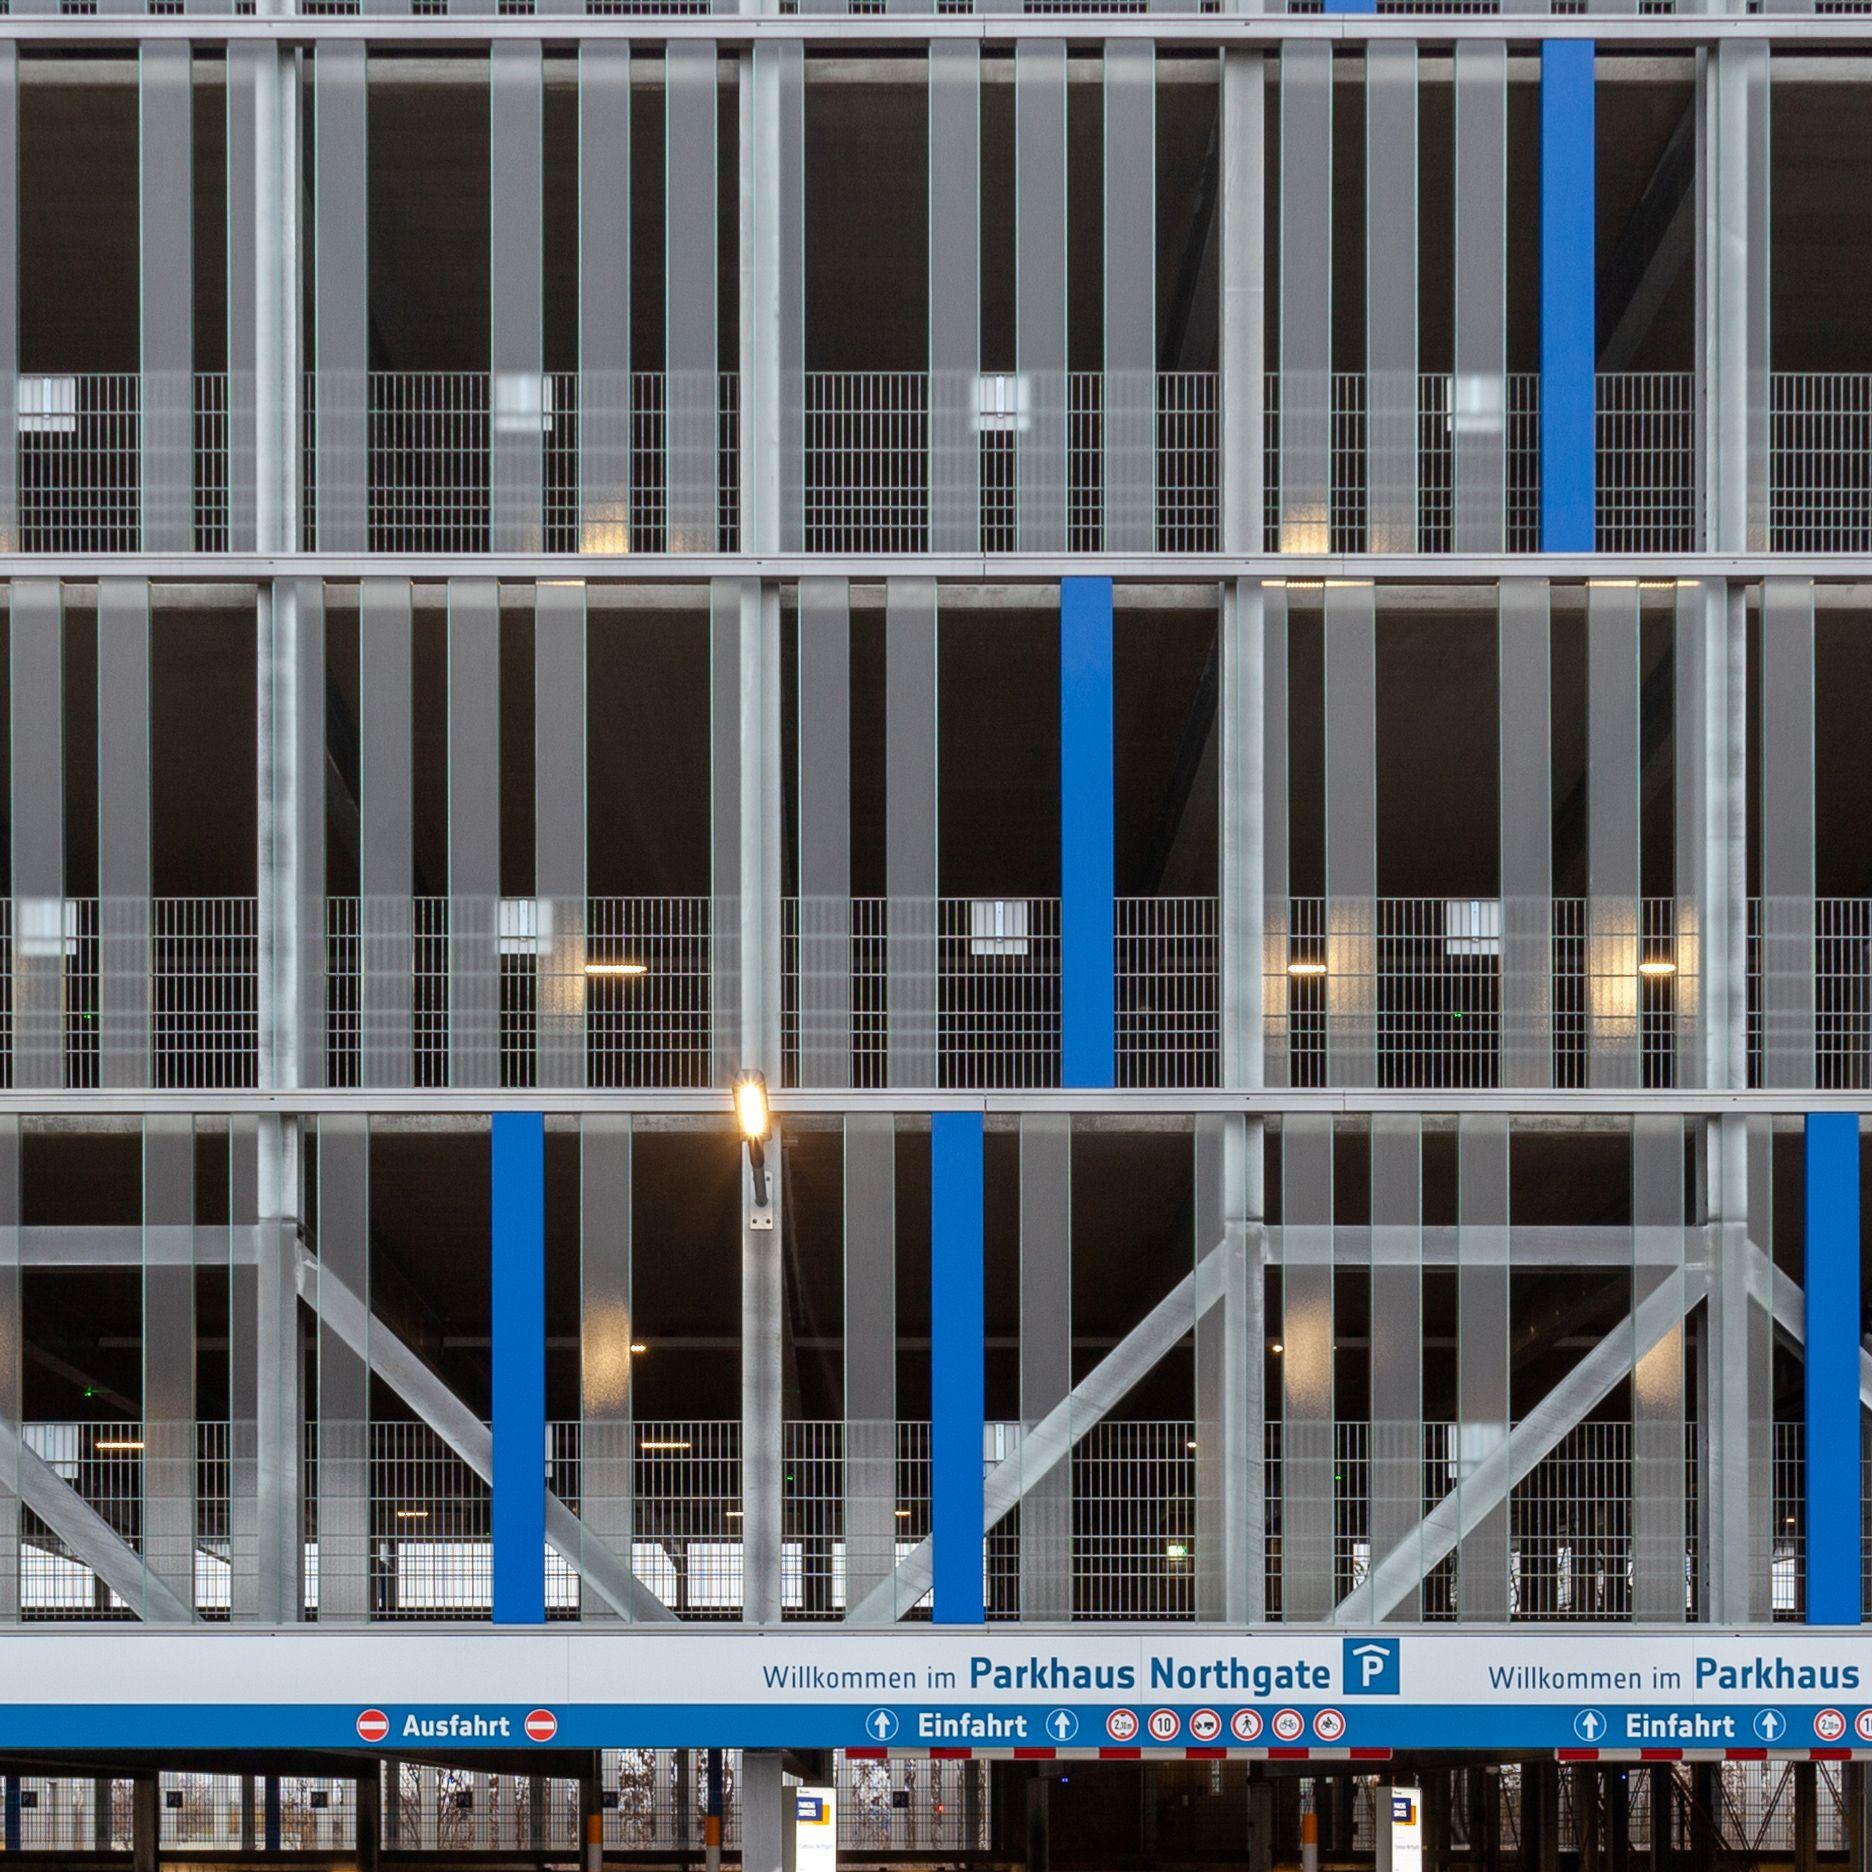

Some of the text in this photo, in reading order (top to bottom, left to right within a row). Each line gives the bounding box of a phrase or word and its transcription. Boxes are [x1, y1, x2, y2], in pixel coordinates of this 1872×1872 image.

[763, 1656, 1331, 1698] Willkommen im Parkhaus Northgate
[1488, 1666, 1641, 1690] Willkommen
[1653, 1666, 1681, 1689] im
[1696, 1657, 1860, 1690] Parkhaus
[402, 1714, 510, 1737] Ausfahrt
[918, 1713, 1027, 1738] Einfahrt
[1157, 1717, 1171, 1732] 10
[1626, 1713, 1735, 1738] Einfahrt
